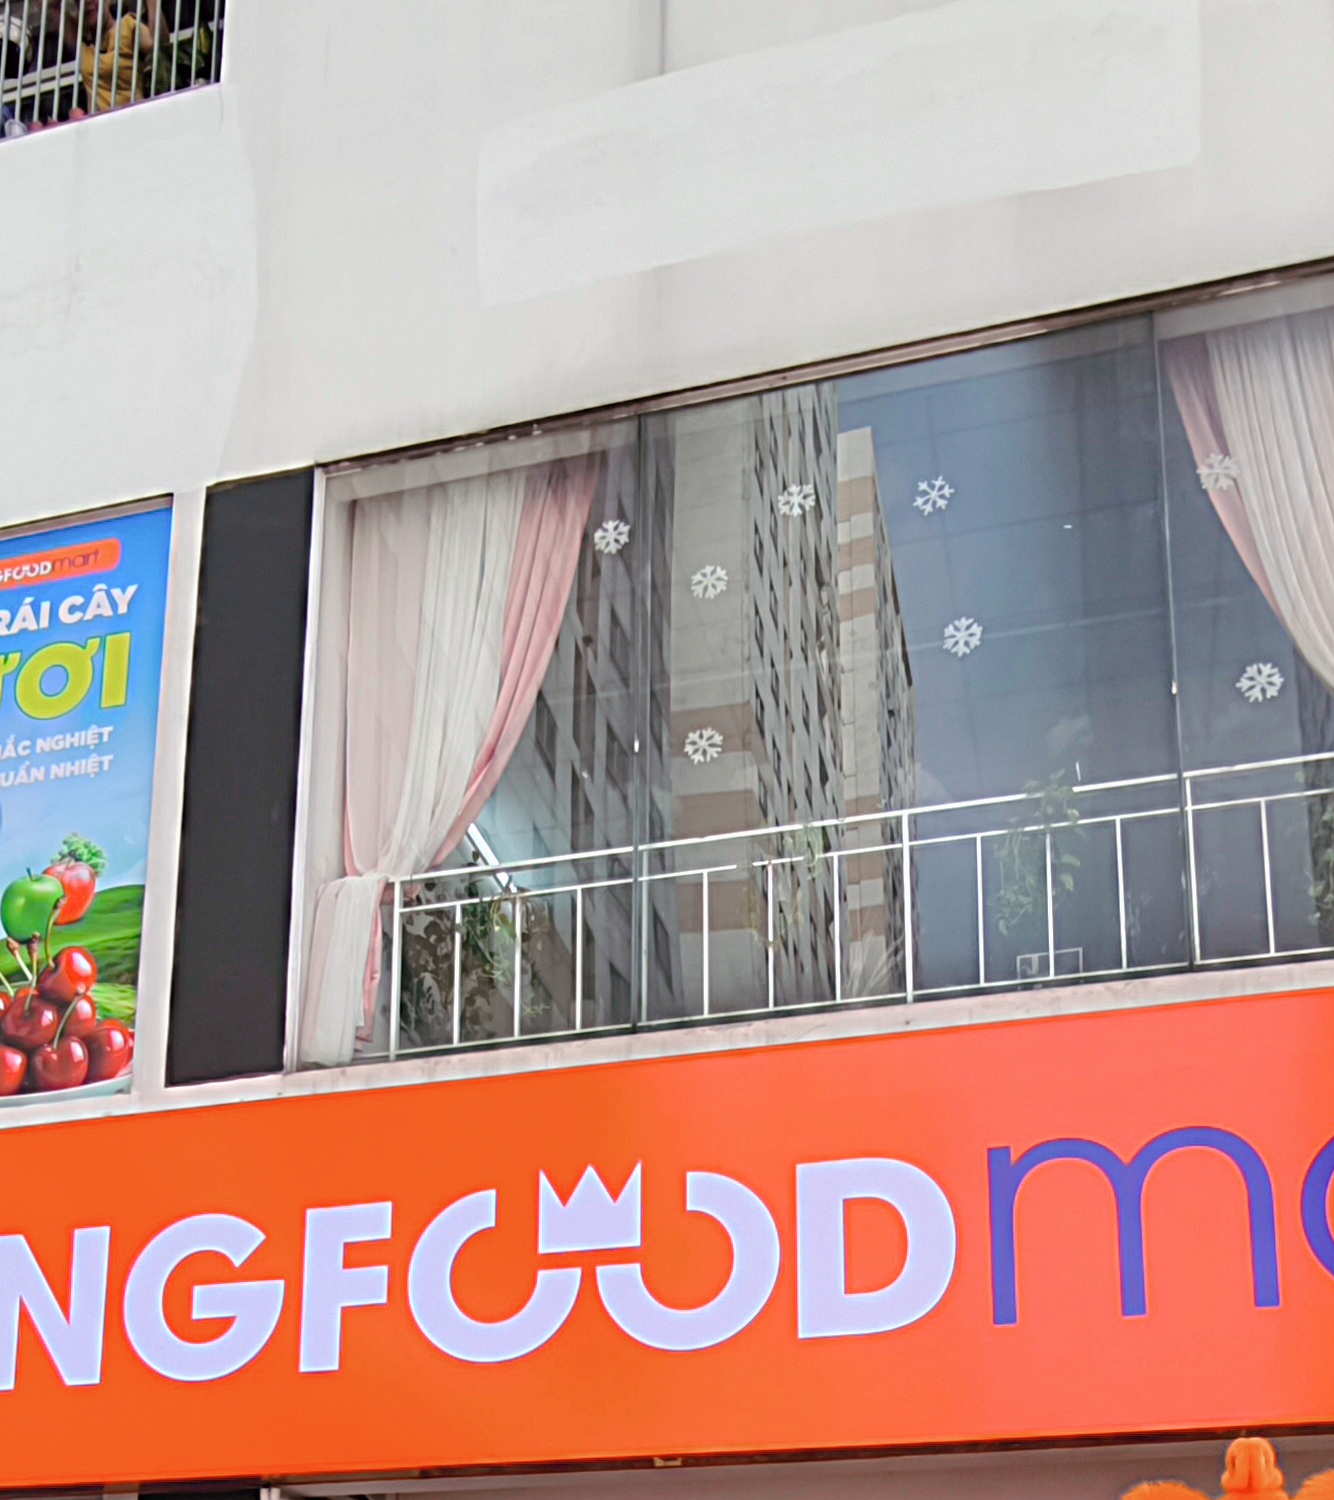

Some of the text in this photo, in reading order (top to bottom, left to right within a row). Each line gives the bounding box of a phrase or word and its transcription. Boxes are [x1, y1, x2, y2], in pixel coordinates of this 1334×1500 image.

[58, 583, 139, 625] CÂY
[35, 725, 113, 754] NGHIỆT
[50, 754, 114, 781] NHIỆT
